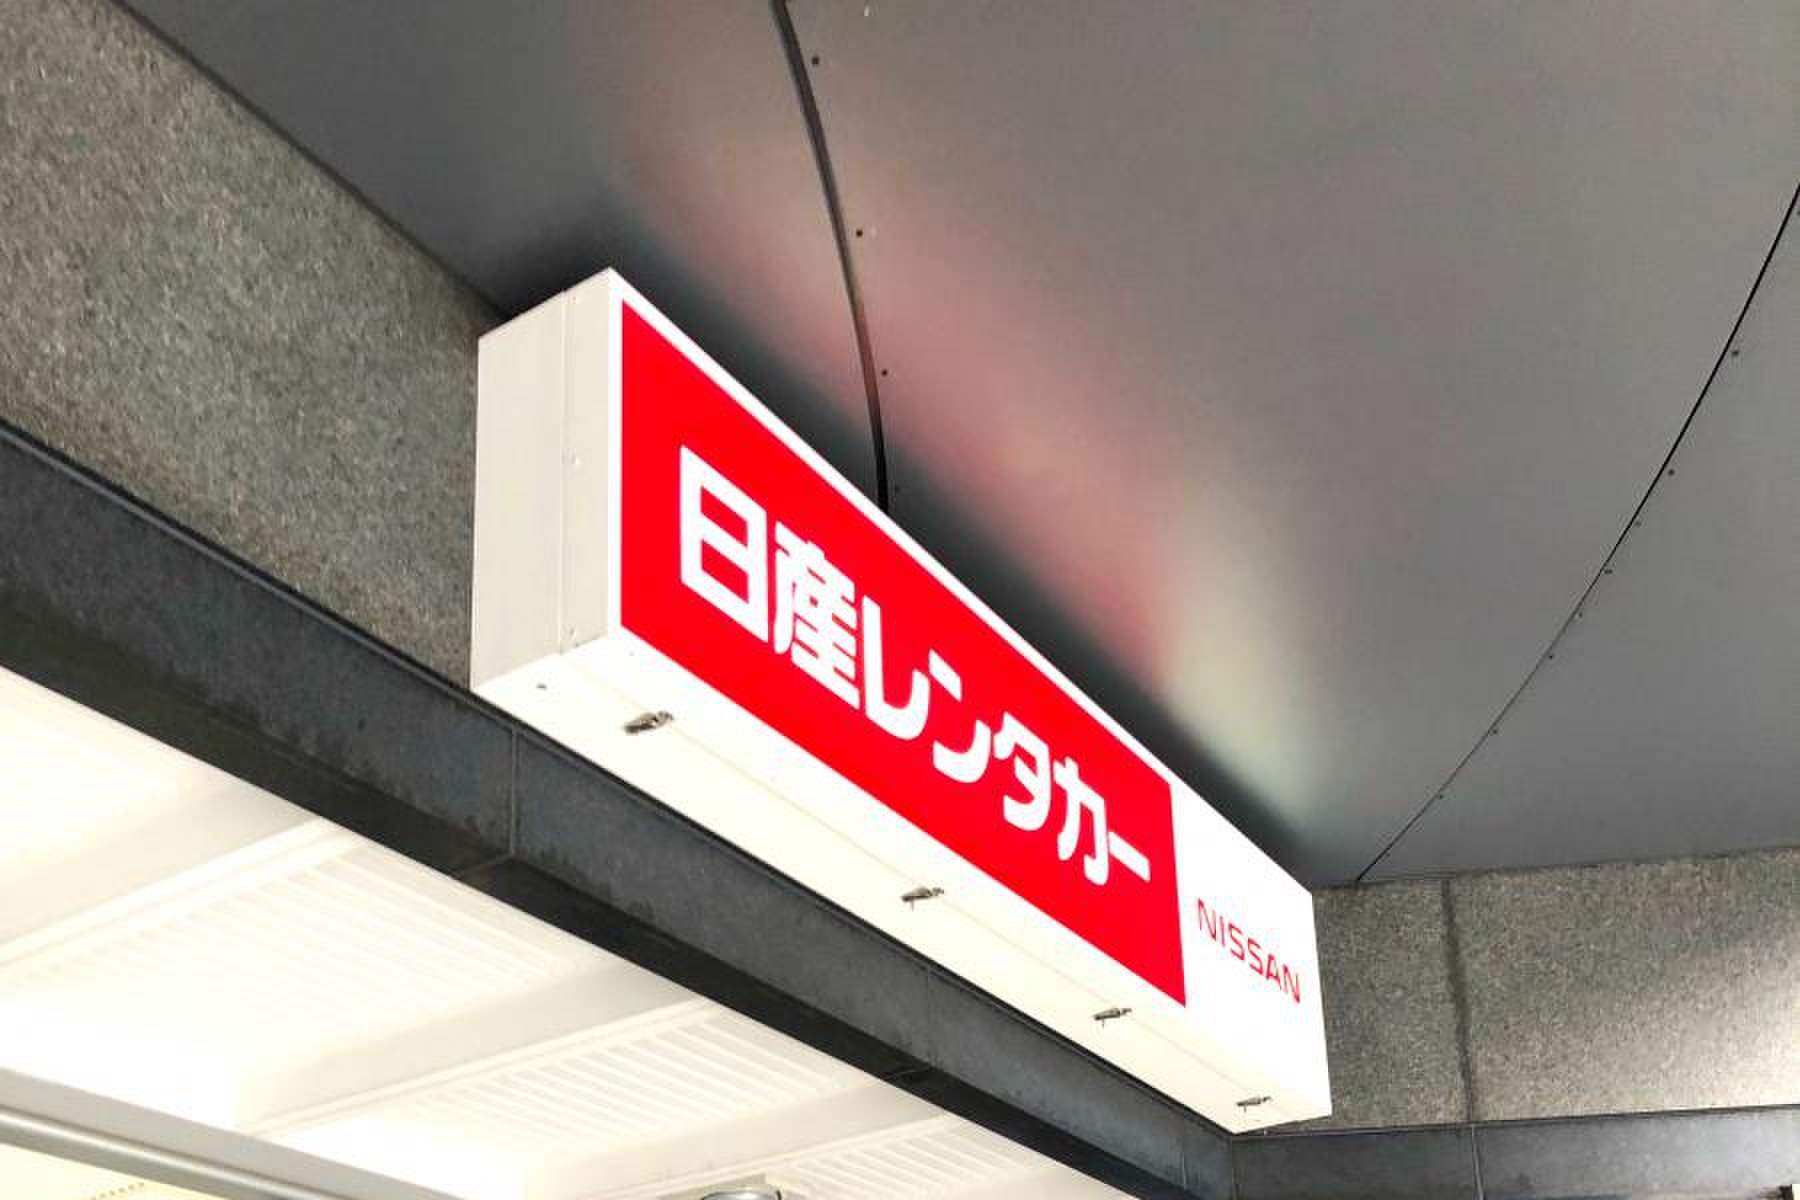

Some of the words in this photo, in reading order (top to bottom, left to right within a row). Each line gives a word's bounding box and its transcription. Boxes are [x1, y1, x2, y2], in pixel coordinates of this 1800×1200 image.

[680, 445, 1150, 885] 日産レンタカー
[1197, 898, 1301, 1003] NISSAN
